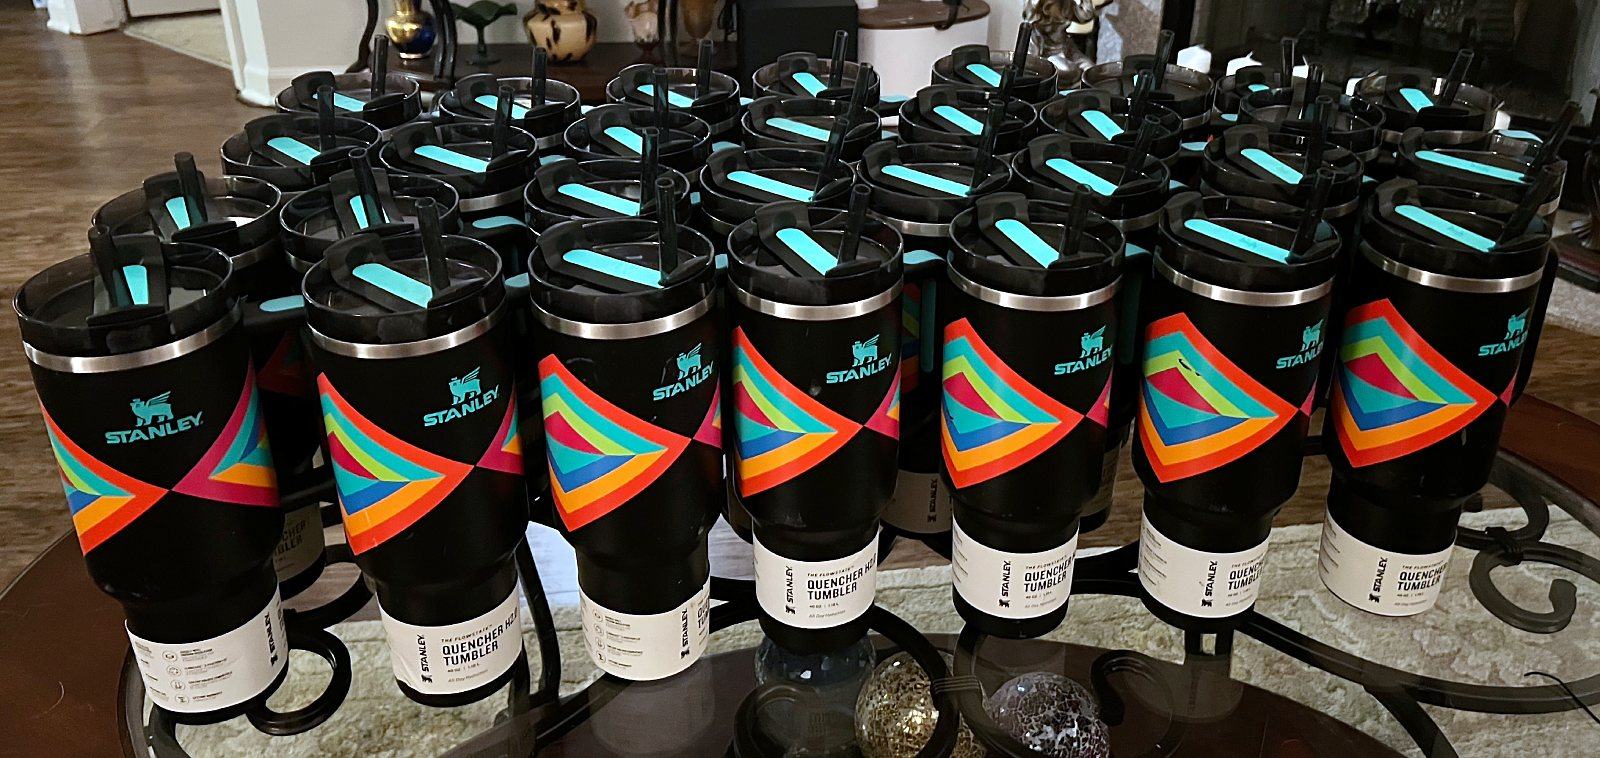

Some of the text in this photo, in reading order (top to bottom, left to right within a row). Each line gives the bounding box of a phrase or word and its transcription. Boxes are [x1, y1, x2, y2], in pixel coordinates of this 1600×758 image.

[826, 353, 892, 385] STANLEY
[1054, 344, 1113, 376] STANLEY
[653, 361, 714, 402] STANLEY
[423, 385, 500, 427] STANLEY
[104, 411, 203, 446] STANLEY
[785, 565, 794, 604] STANLEY
[806, 581, 857, 601] TUMBLER
[807, 567, 864, 590] QUENCHER
[1001, 560, 1011, 598] STANLEY
[1024, 570, 1067, 593] TUMBLER
[1204, 560, 1218, 597] STANLEY
[1373, 556, 1388, 593] STANLEY
[1397, 575, 1441, 591] TUMBLER
[442, 625, 504, 656] QUENCHER
[681, 608, 689, 648] STANLEY
[417, 634, 429, 673] STANLEY
[443, 640, 499, 667] TUMBLER
